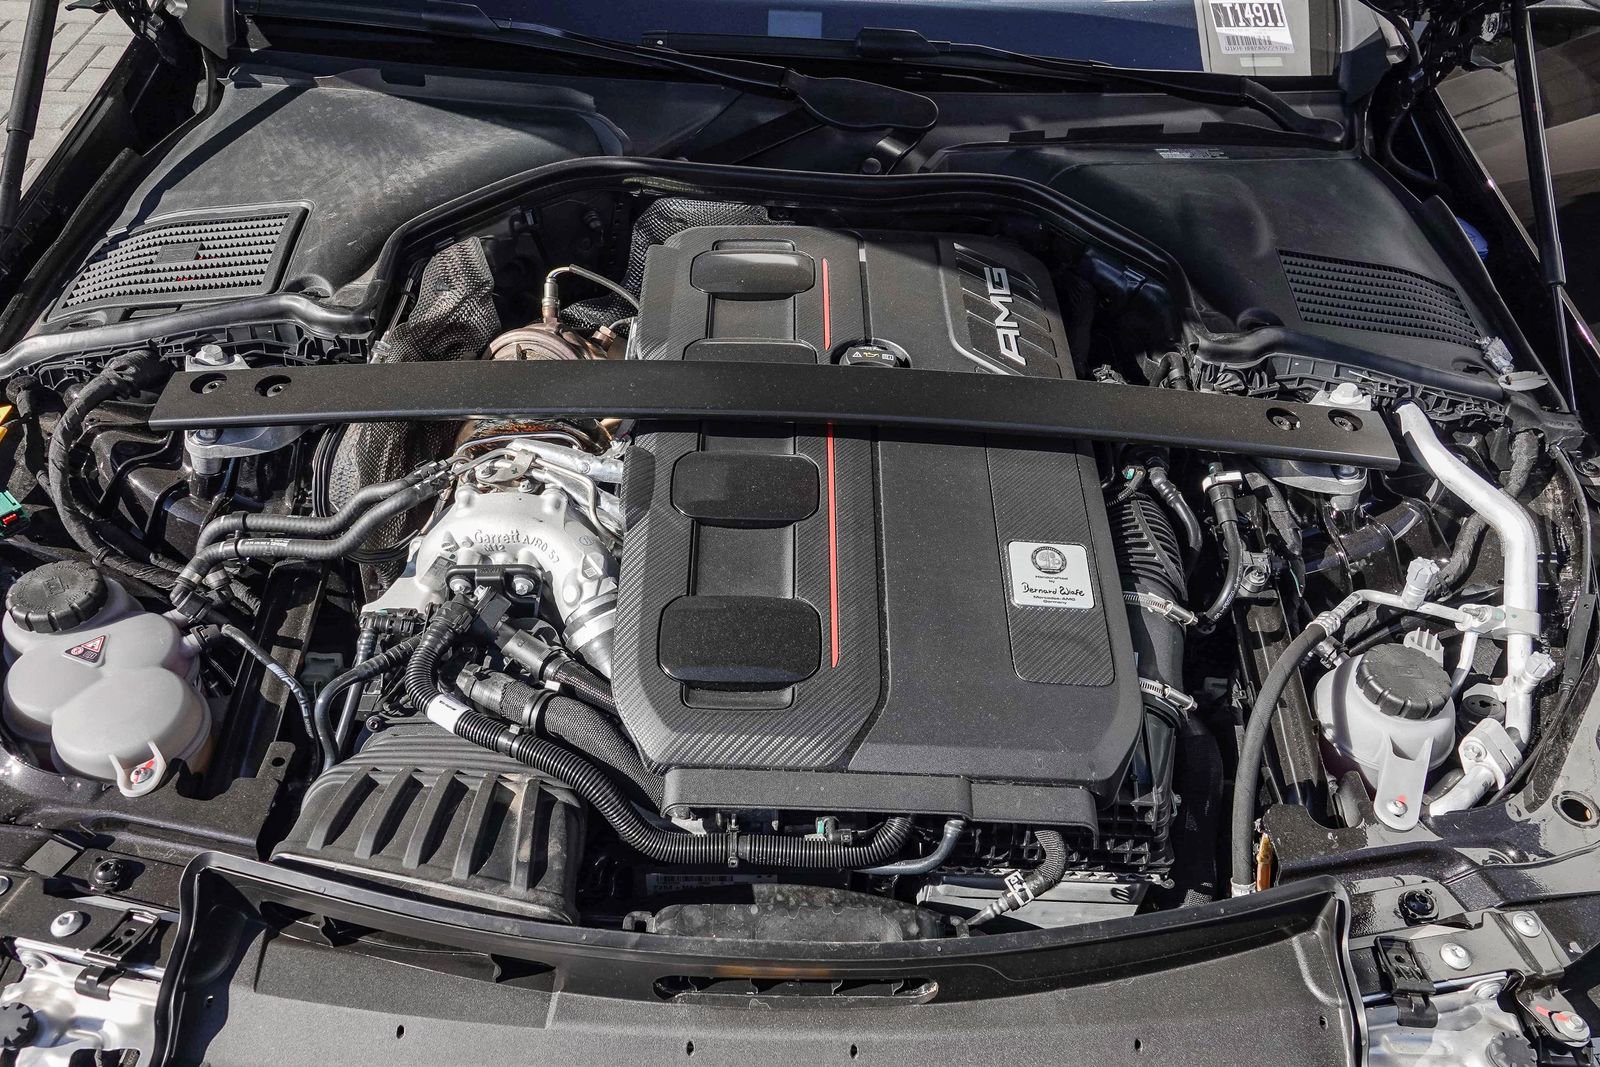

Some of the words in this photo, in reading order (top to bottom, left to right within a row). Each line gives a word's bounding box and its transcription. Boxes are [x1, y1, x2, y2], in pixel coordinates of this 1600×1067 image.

[984, 266, 1026, 366] AMG
[474, 529, 521, 545] Garrett
[1021, 581, 1058, 595] Bernard
